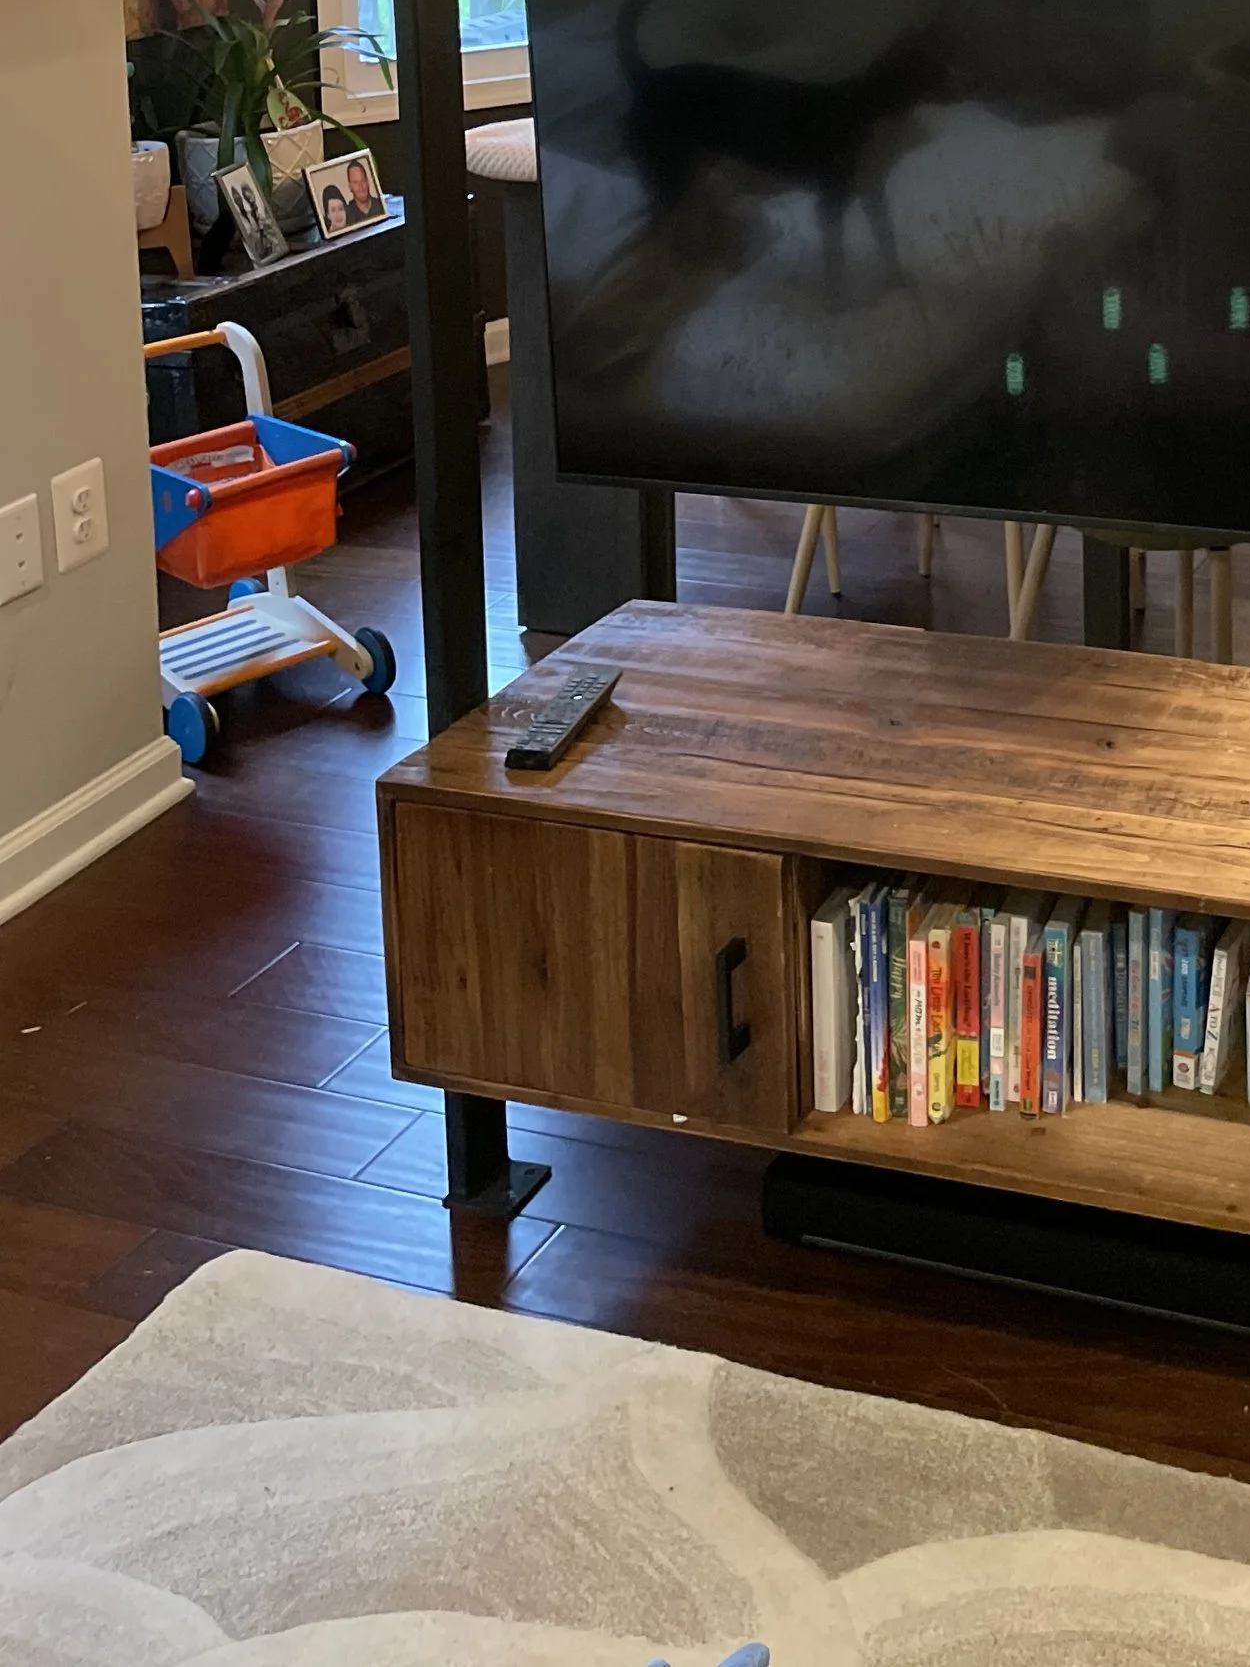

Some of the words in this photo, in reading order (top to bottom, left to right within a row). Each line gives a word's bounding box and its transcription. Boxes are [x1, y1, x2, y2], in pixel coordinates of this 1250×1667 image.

[890, 955, 906, 999] Happy
[1046, 976, 1060, 1060] meditation
[1208, 1003, 1221, 1013] A
